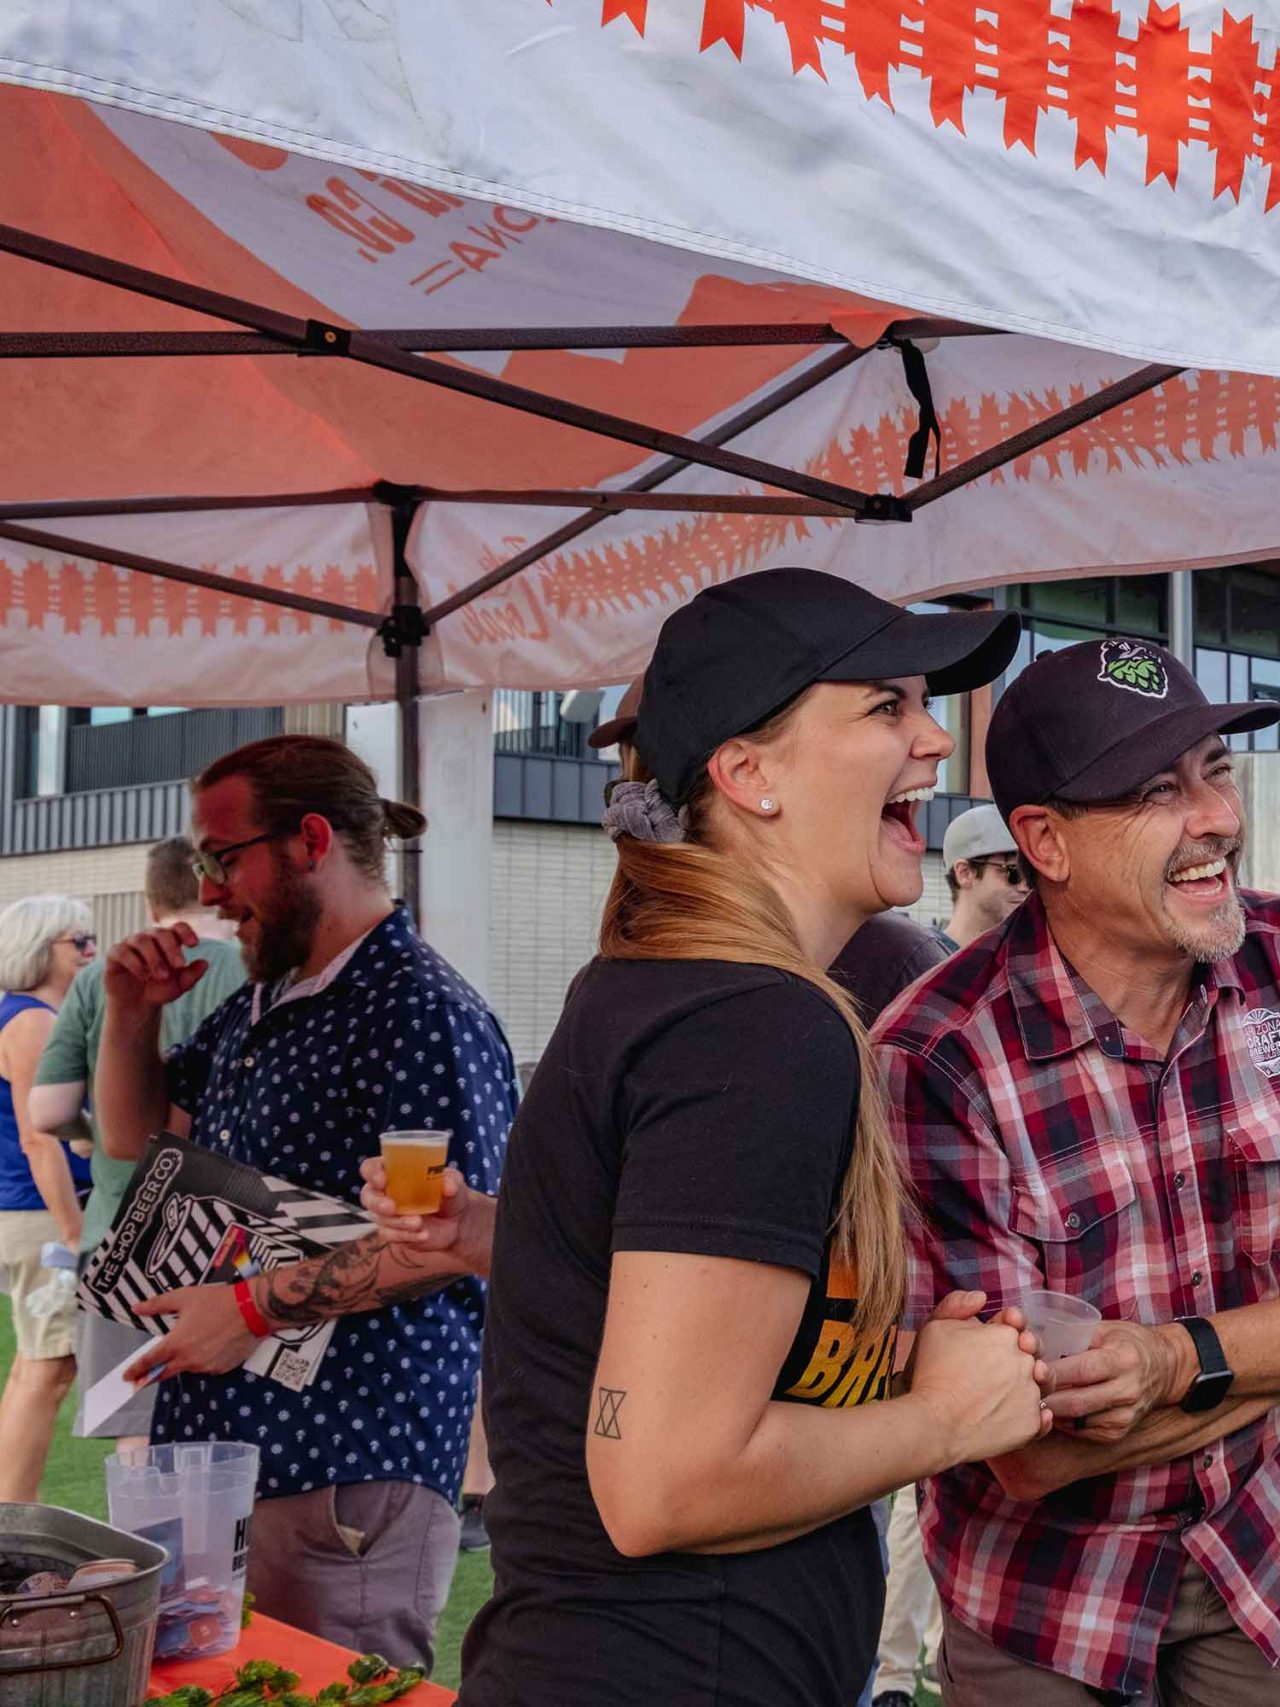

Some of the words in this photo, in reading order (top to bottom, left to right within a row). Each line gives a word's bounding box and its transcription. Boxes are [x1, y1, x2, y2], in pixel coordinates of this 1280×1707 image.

[96, 1262, 119, 1289] THE
[112, 1223, 136, 1261] SHOP
[132, 1181, 159, 1223] BEER
